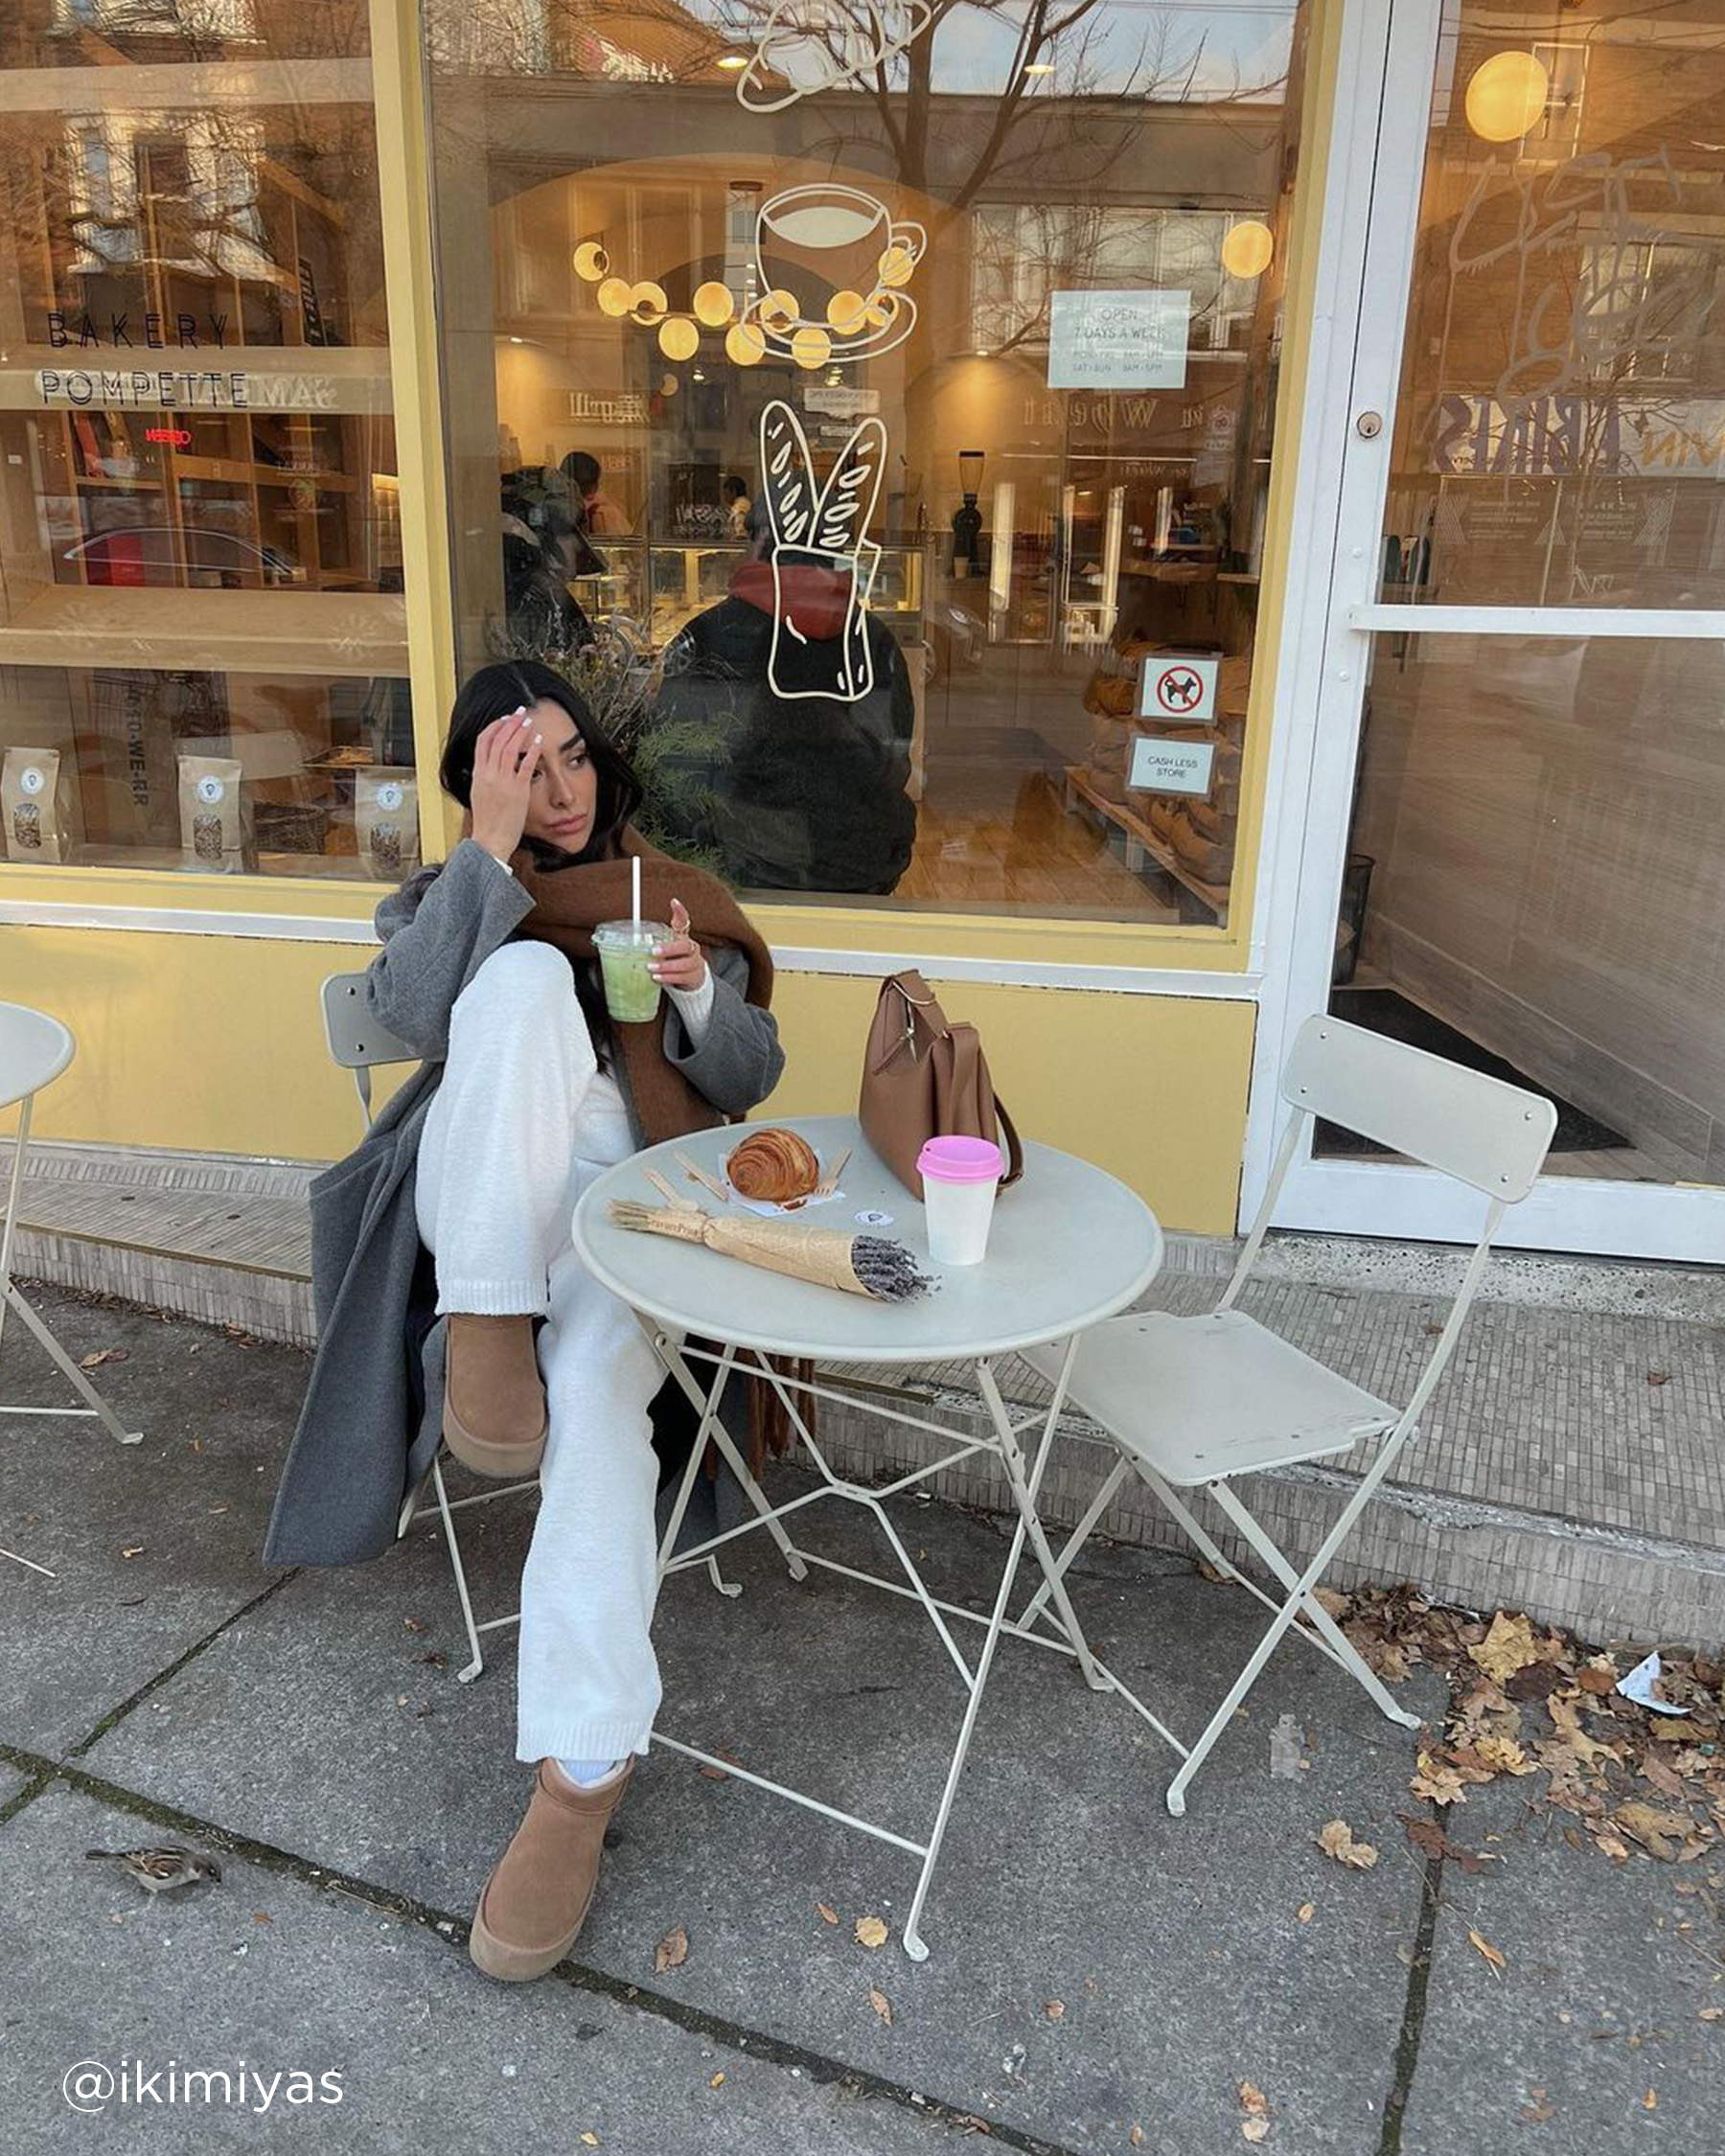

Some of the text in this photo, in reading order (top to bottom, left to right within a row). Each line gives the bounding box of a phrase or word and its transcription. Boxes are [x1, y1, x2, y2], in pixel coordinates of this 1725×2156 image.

[1100, 308, 1138, 321] OPEN
[47, 311, 229, 349] BAKERY
[41, 370, 248, 408] POMPETTE
[1147, 755, 1199, 768] CASH LESS
[1156, 767, 1186, 778] STORE
